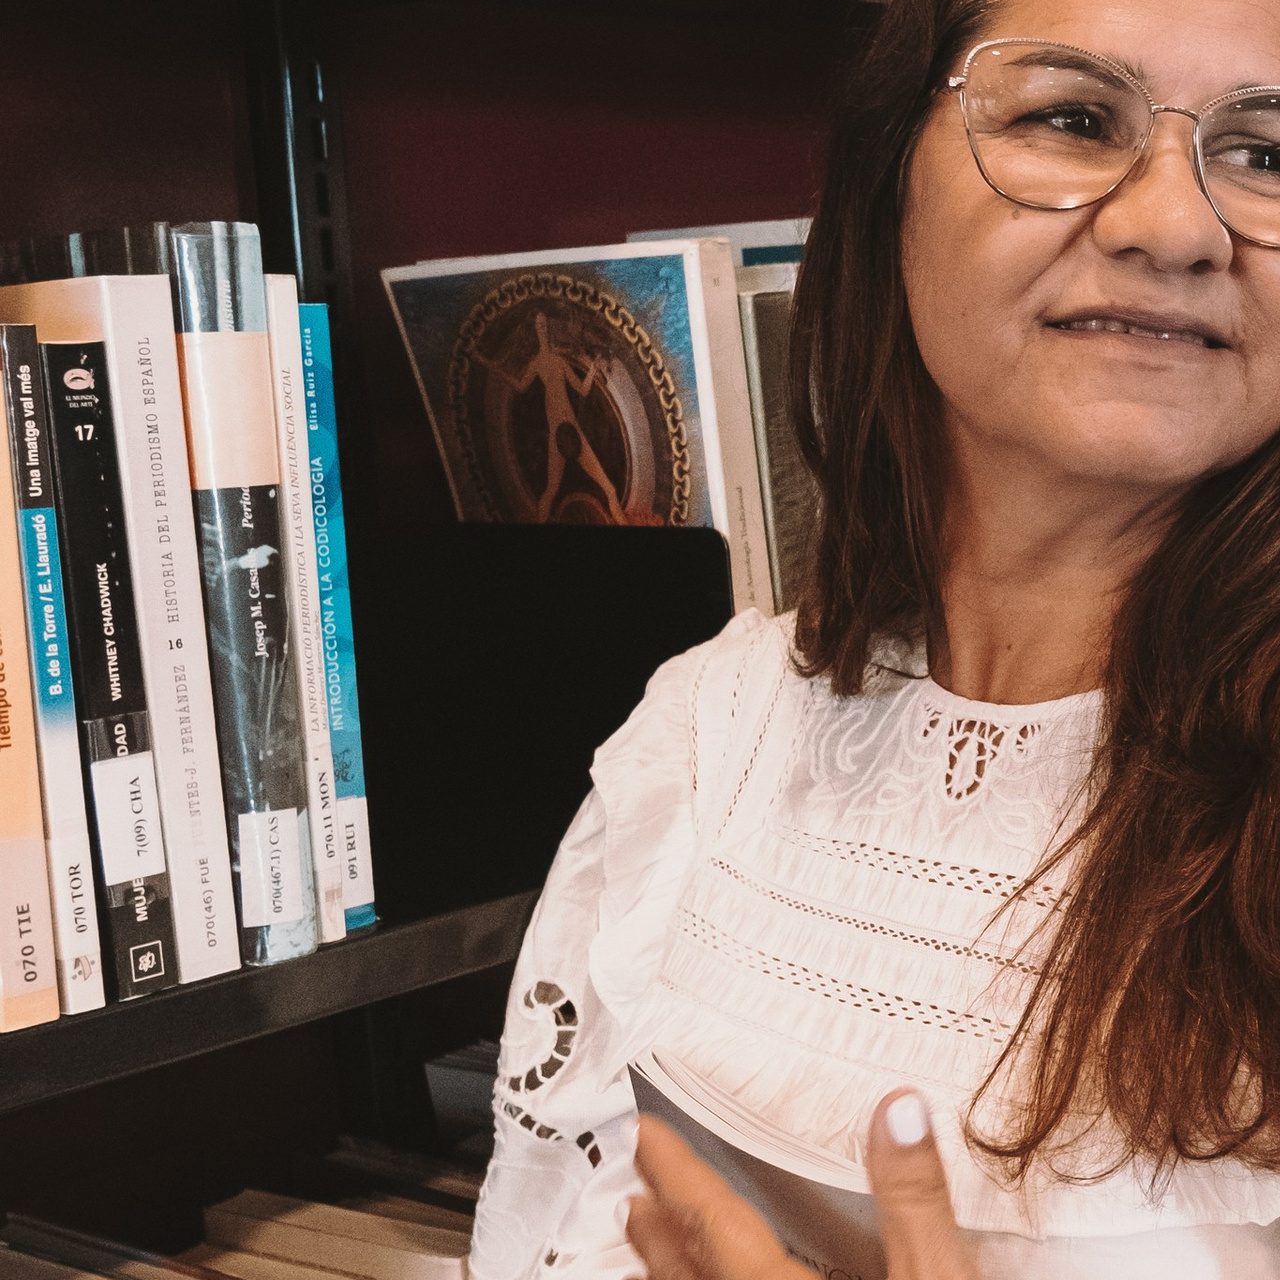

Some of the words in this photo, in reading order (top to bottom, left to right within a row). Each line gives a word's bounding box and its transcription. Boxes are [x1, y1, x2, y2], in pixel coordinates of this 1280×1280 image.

[19, 363, 33, 392] més
[137, 336, 157, 407] ESPAÑOL
[280, 367, 292, 412] SOCIAL
[306, 371, 317, 398] Ruiz
[23, 393, 36, 419] val
[309, 403, 320, 431] Elisa
[24, 420, 42, 471] imatge
[74, 424, 94, 440] 17
[146, 412, 167, 508] PERIODISMO
[284, 413, 300, 488] INFLUÈNCIA
[28, 473, 43, 499] Una
[290, 490, 302, 522] SEVA
[34, 513, 51, 576] Llauradó
[158, 514, 170, 544] DEL
[293, 524, 304, 540] LA
[41, 579, 53, 594] E.
[95, 561, 116, 636] CHADWICK
[163, 551, 181, 625] HISTORIA
[295, 549, 312, 635] PERIODÍSTICA
[320, 572, 333, 591] LA
[250, 599, 264, 619] M.
[323, 595, 335, 607] A
[43, 603, 57, 641] Torre
[253, 621, 269, 658] Josep
[46, 643, 58, 657] la
[168, 638, 184, 651] 16
[47, 660, 60, 679] de
[102, 638, 122, 703] WHITNEY
[303, 637, 320, 713] INFORMACIÓ
[324, 609, 343, 732] INTRODUCCIÓN
[49, 681, 64, 696] B.
[174, 664, 195, 755] FERNÁNDEZ
[310, 715, 321, 733] LA
[115, 722, 129, 757] DAD
[128, 775, 143, 816] CHA
[318, 771, 332, 811] MON
[135, 818, 149, 857] 7(09)
[267, 816, 280, 846] CAS
[323, 814, 336, 859] 070.11
[344, 822, 355, 850] RUI
[68, 862, 82, 901] TOR
[197, 856, 211, 886] FUE
[269, 848, 284, 914] 070(467.1)
[347, 855, 359, 880] 091
[16, 902, 31, 939] TIE
[74, 905, 88, 934] 070
[199, 888, 217, 948] 070(46)
[22, 946, 38, 983] 070
